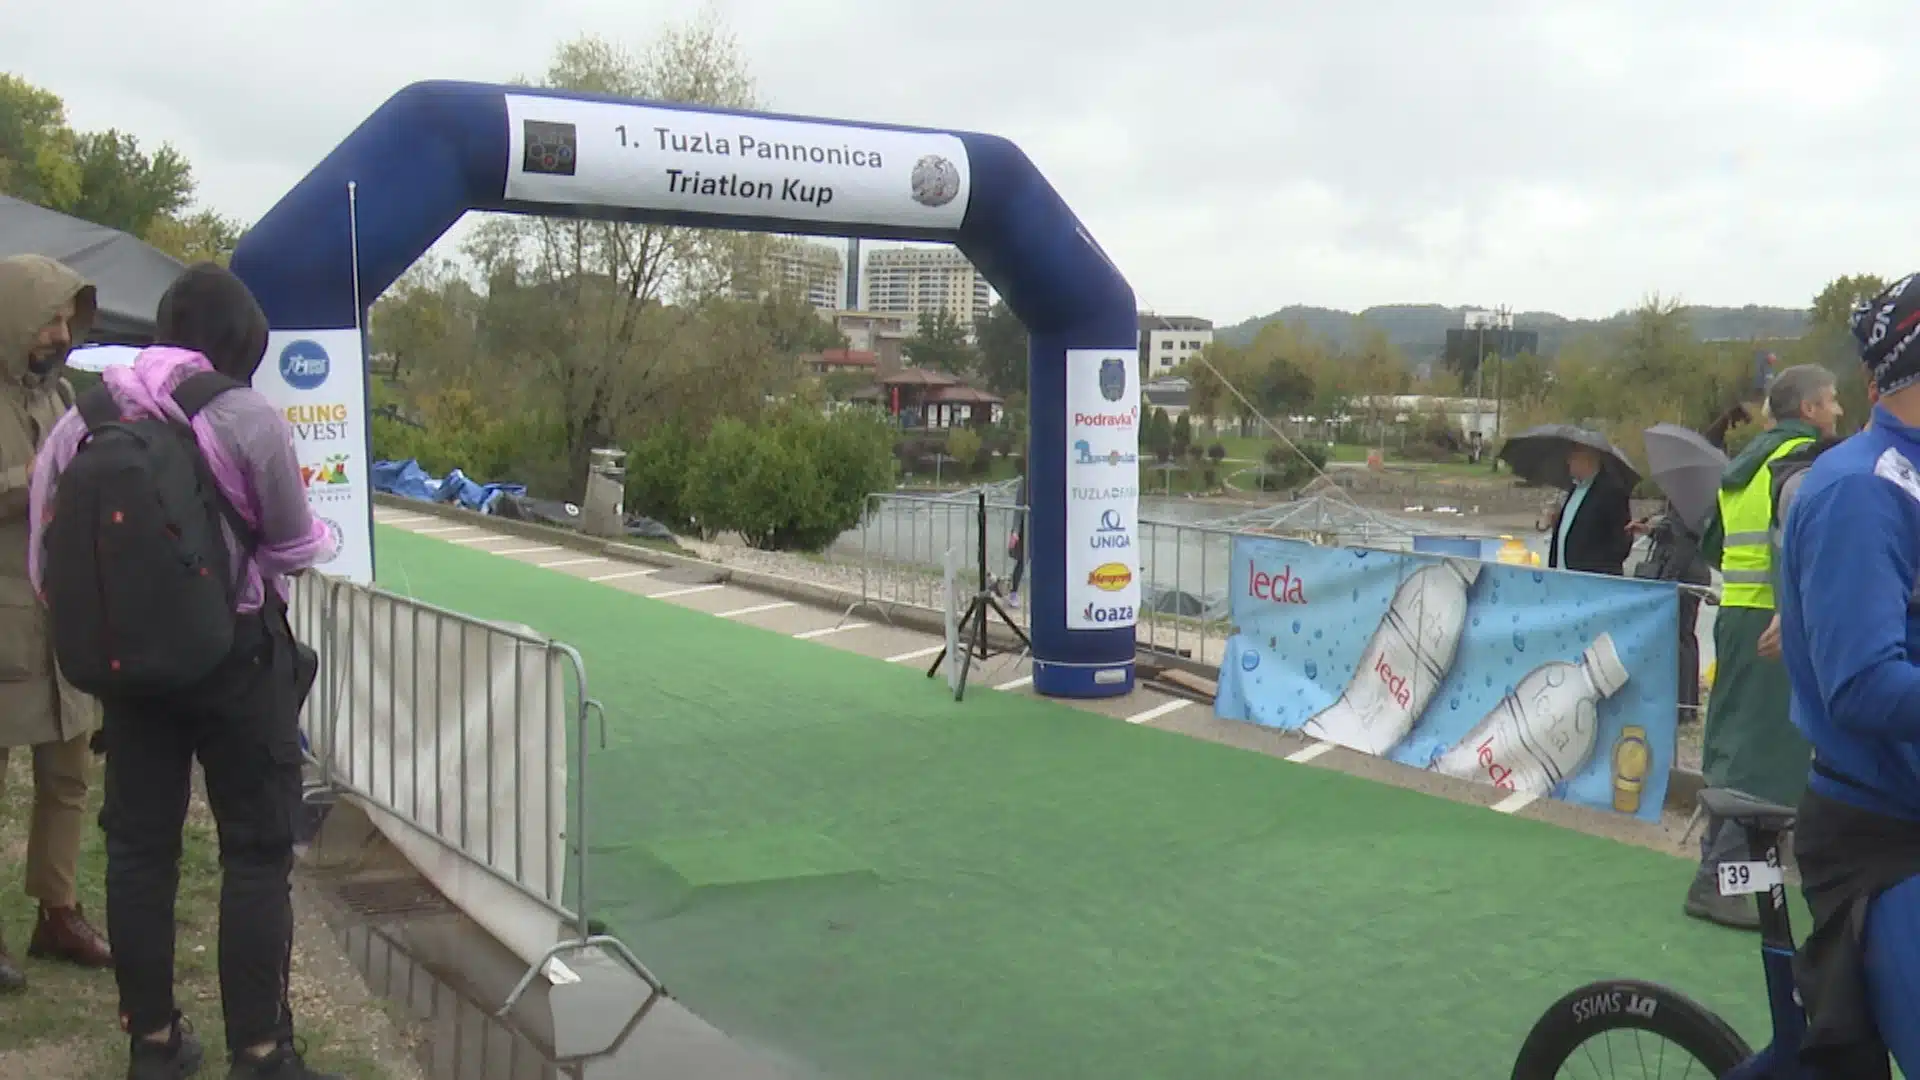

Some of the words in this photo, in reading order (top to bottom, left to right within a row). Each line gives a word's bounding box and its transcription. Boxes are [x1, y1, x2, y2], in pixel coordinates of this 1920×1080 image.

[615, 124, 640, 148] 1.
[654, 127, 731, 156] Tuzla
[739, 134, 883, 168] Pannonica
[666, 168, 773, 200] Triatlon
[782, 178, 833, 207] Kup
[283, 404, 347, 424] ELING
[1074, 412, 1132, 427] Podravka
[1089, 534, 1131, 549] UNIQA
[1248, 559, 1309, 605] leda
[1094, 605, 1133, 622] oaza
[1375, 651, 1411, 710] leda
[1727, 865, 1750, 885] 39
[1572, 992, 1622, 1024] SWISS
[1625, 993, 1658, 1019] DT
